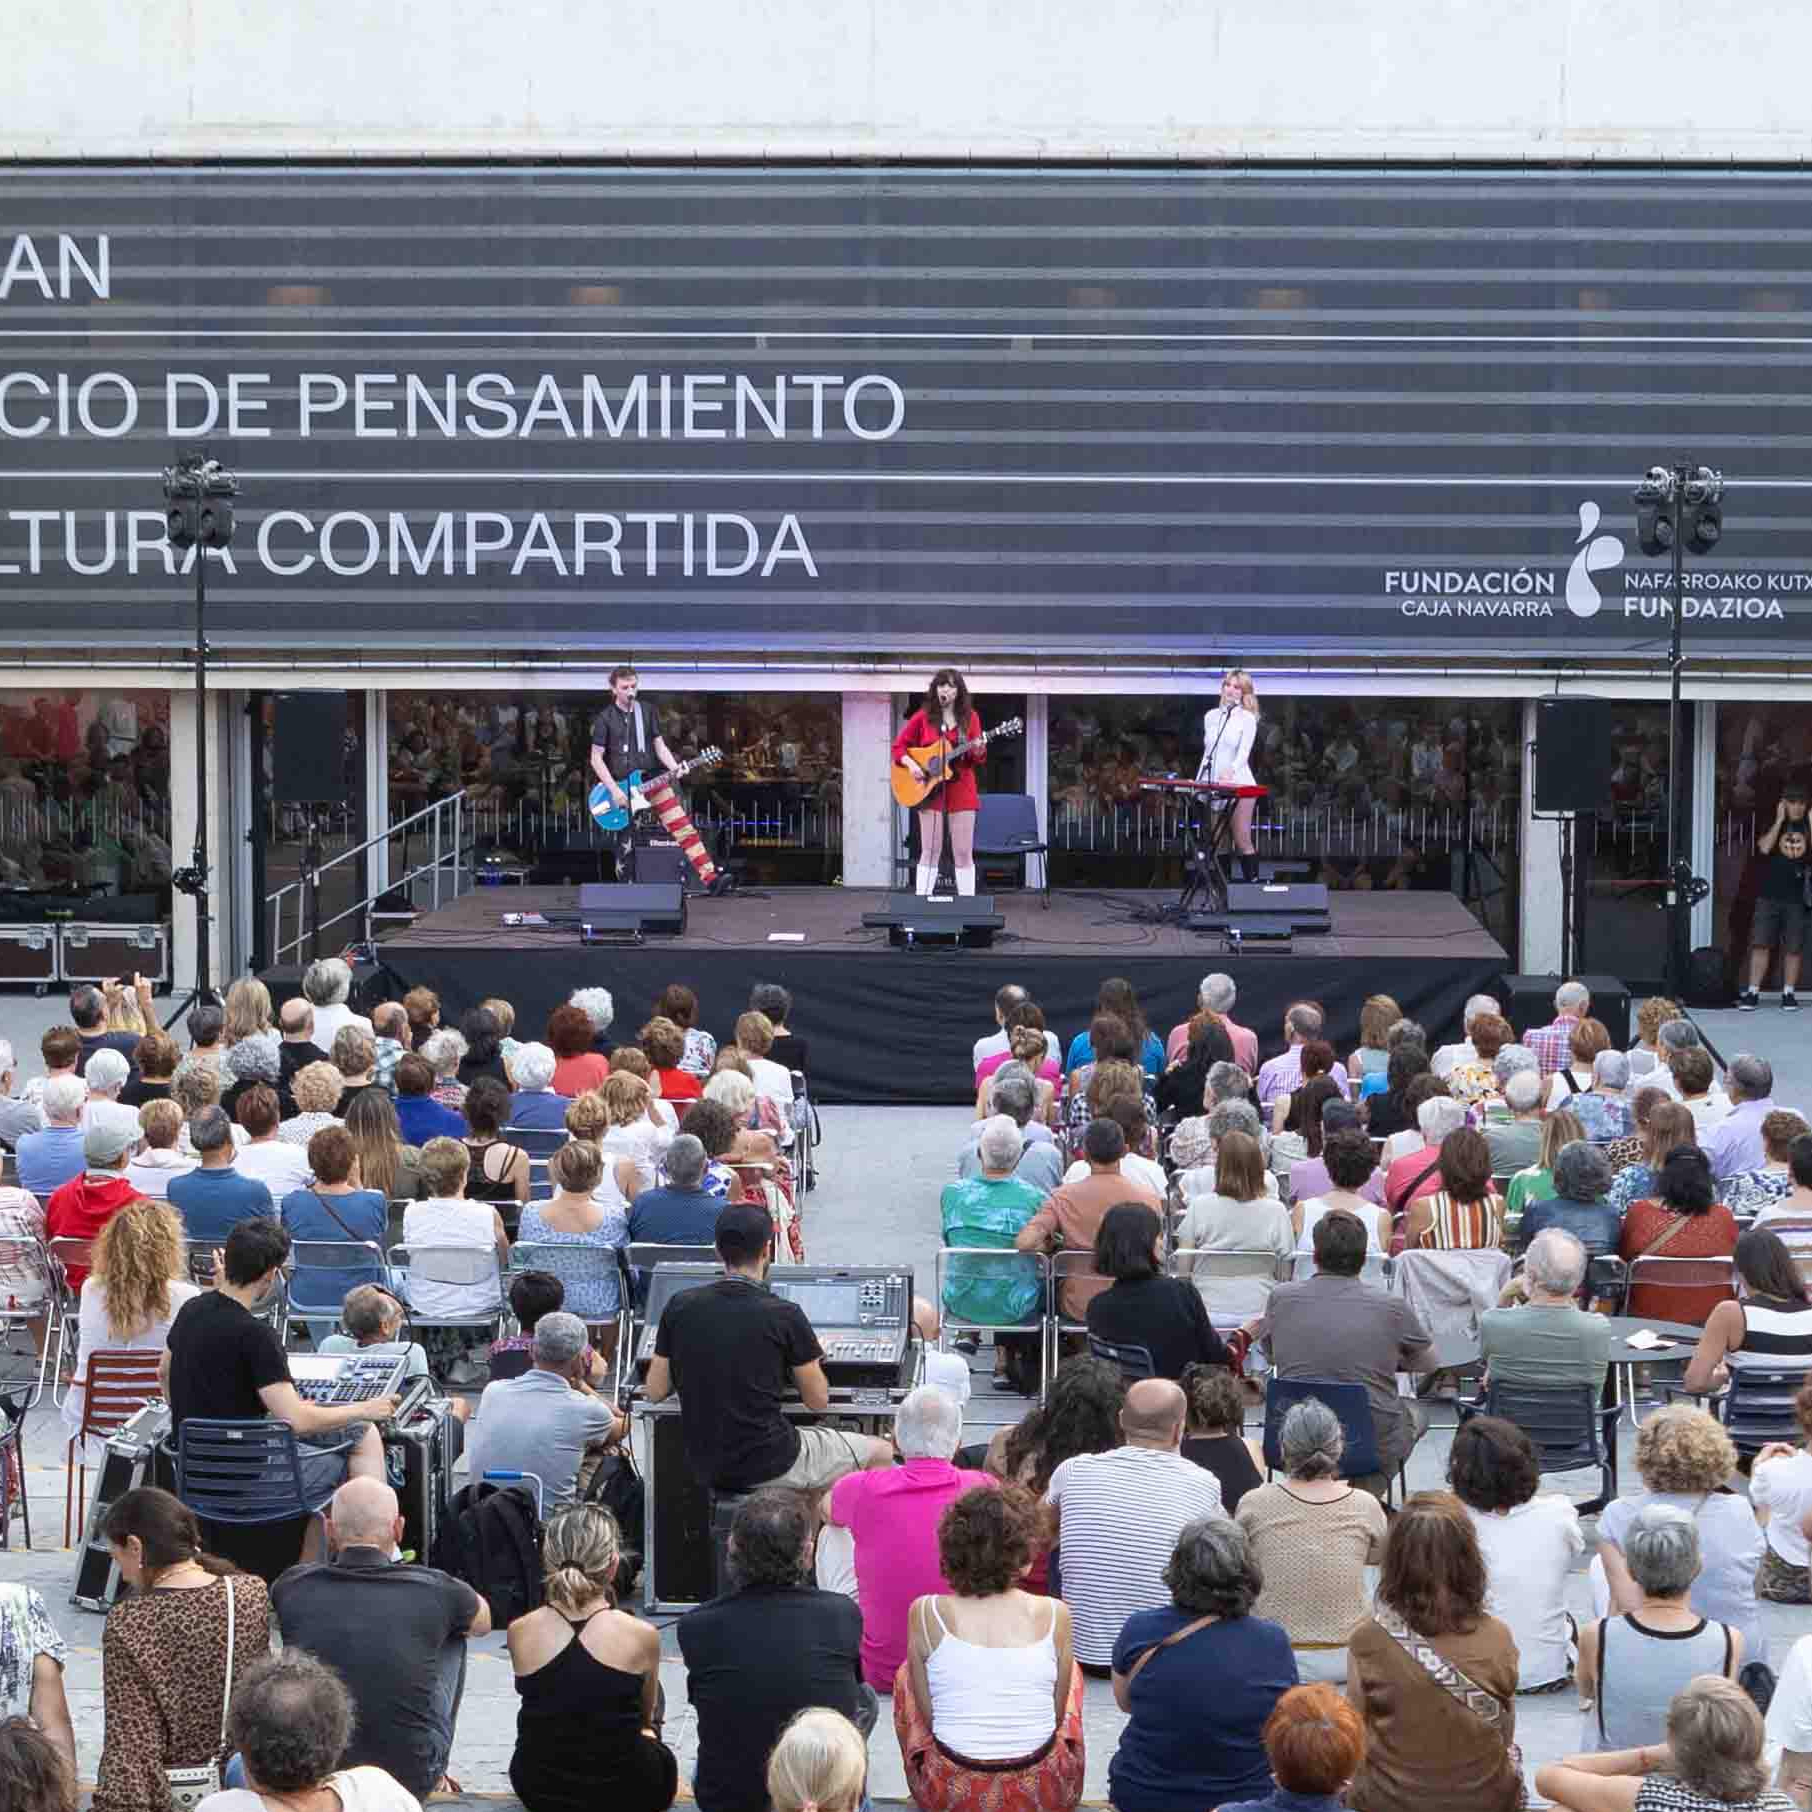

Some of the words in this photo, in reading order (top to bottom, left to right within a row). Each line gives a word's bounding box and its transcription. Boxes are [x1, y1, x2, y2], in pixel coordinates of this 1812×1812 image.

[166, 373, 271, 437] DE
[299, 373, 905, 441] PENSAMIENTO
[257, 510, 819, 577] COMPARTIDA
[1385, 567, 1555, 594] FUNDACIÓN
[1401, 599, 1452, 617] CAJA
[1457, 600, 1554, 617] NAVARRA
[1624, 596, 1784, 619] FUNDAZIOA
